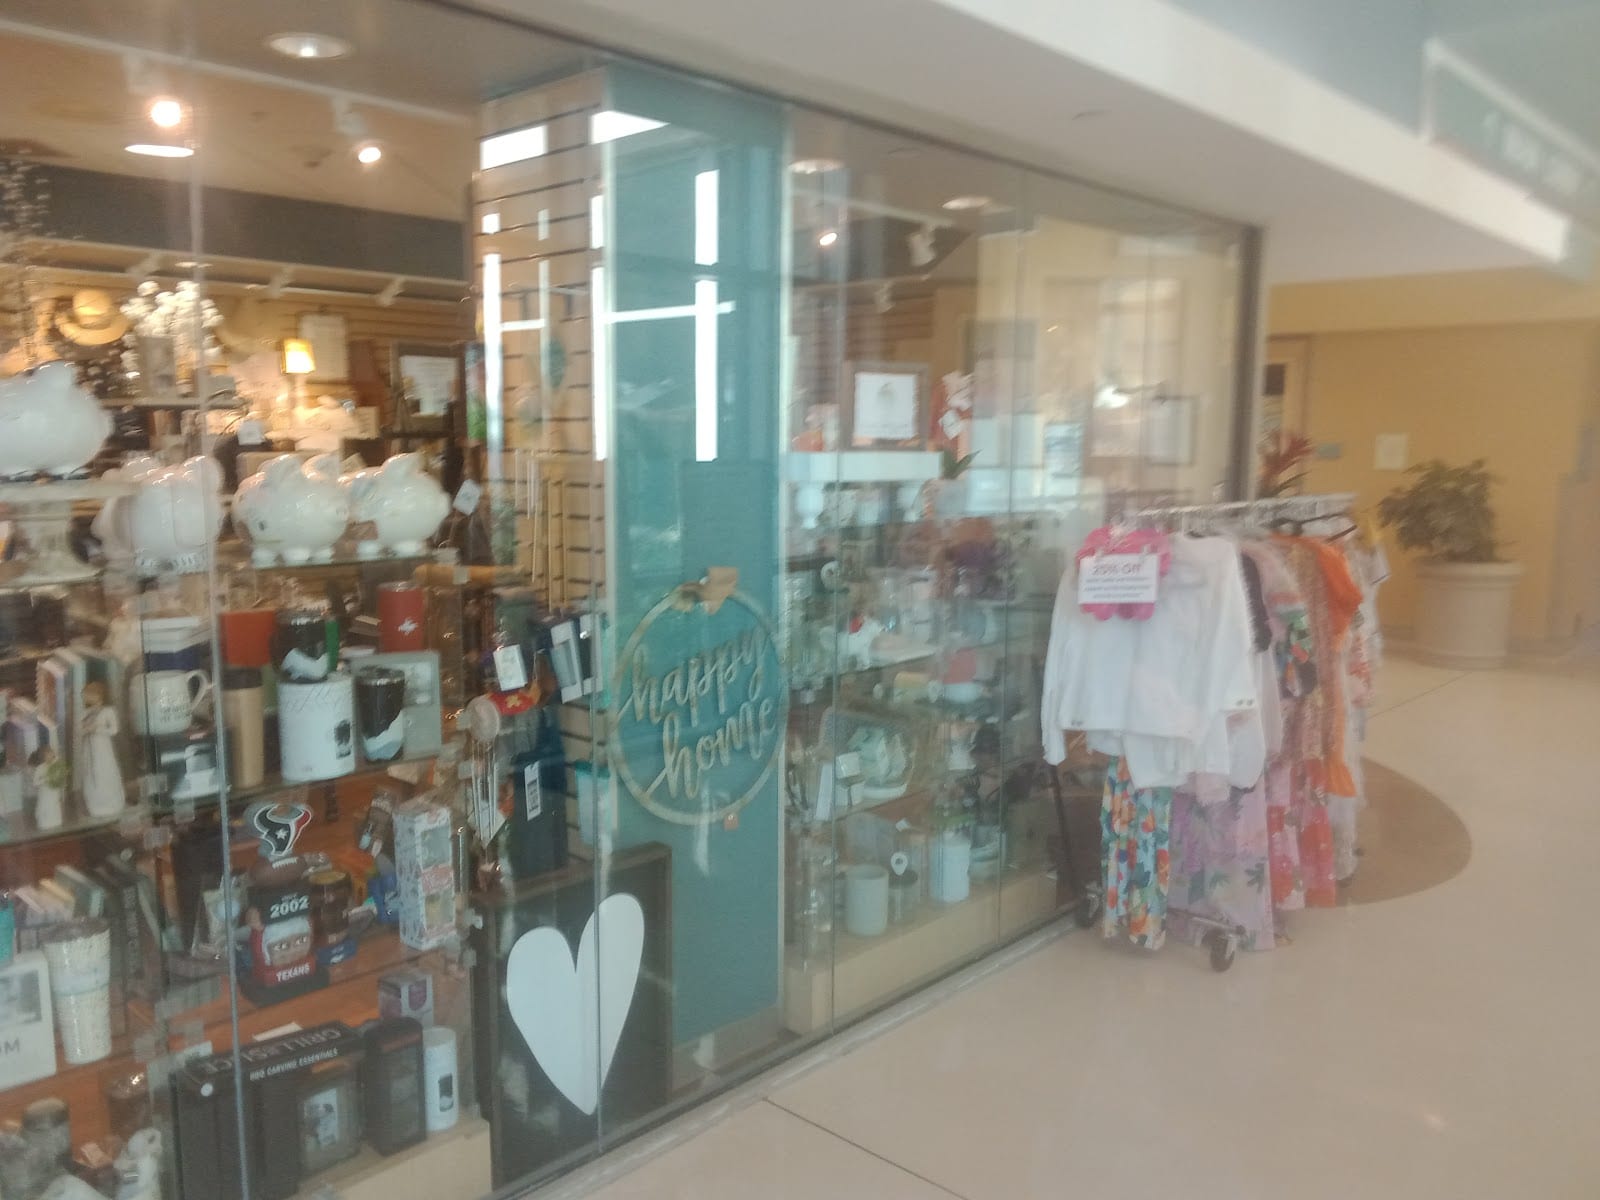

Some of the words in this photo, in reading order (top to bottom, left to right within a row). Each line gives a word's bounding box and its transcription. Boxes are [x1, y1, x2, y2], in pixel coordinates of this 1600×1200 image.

[618, 624, 768, 728] happy
[645, 697, 777, 799] home
[270, 895, 310, 919] 2002
[276, 962, 311, 982] TEXANS
[266, 1058, 298, 1077] CARVING
[299, 1046, 339, 1067] ESSENTIALS
